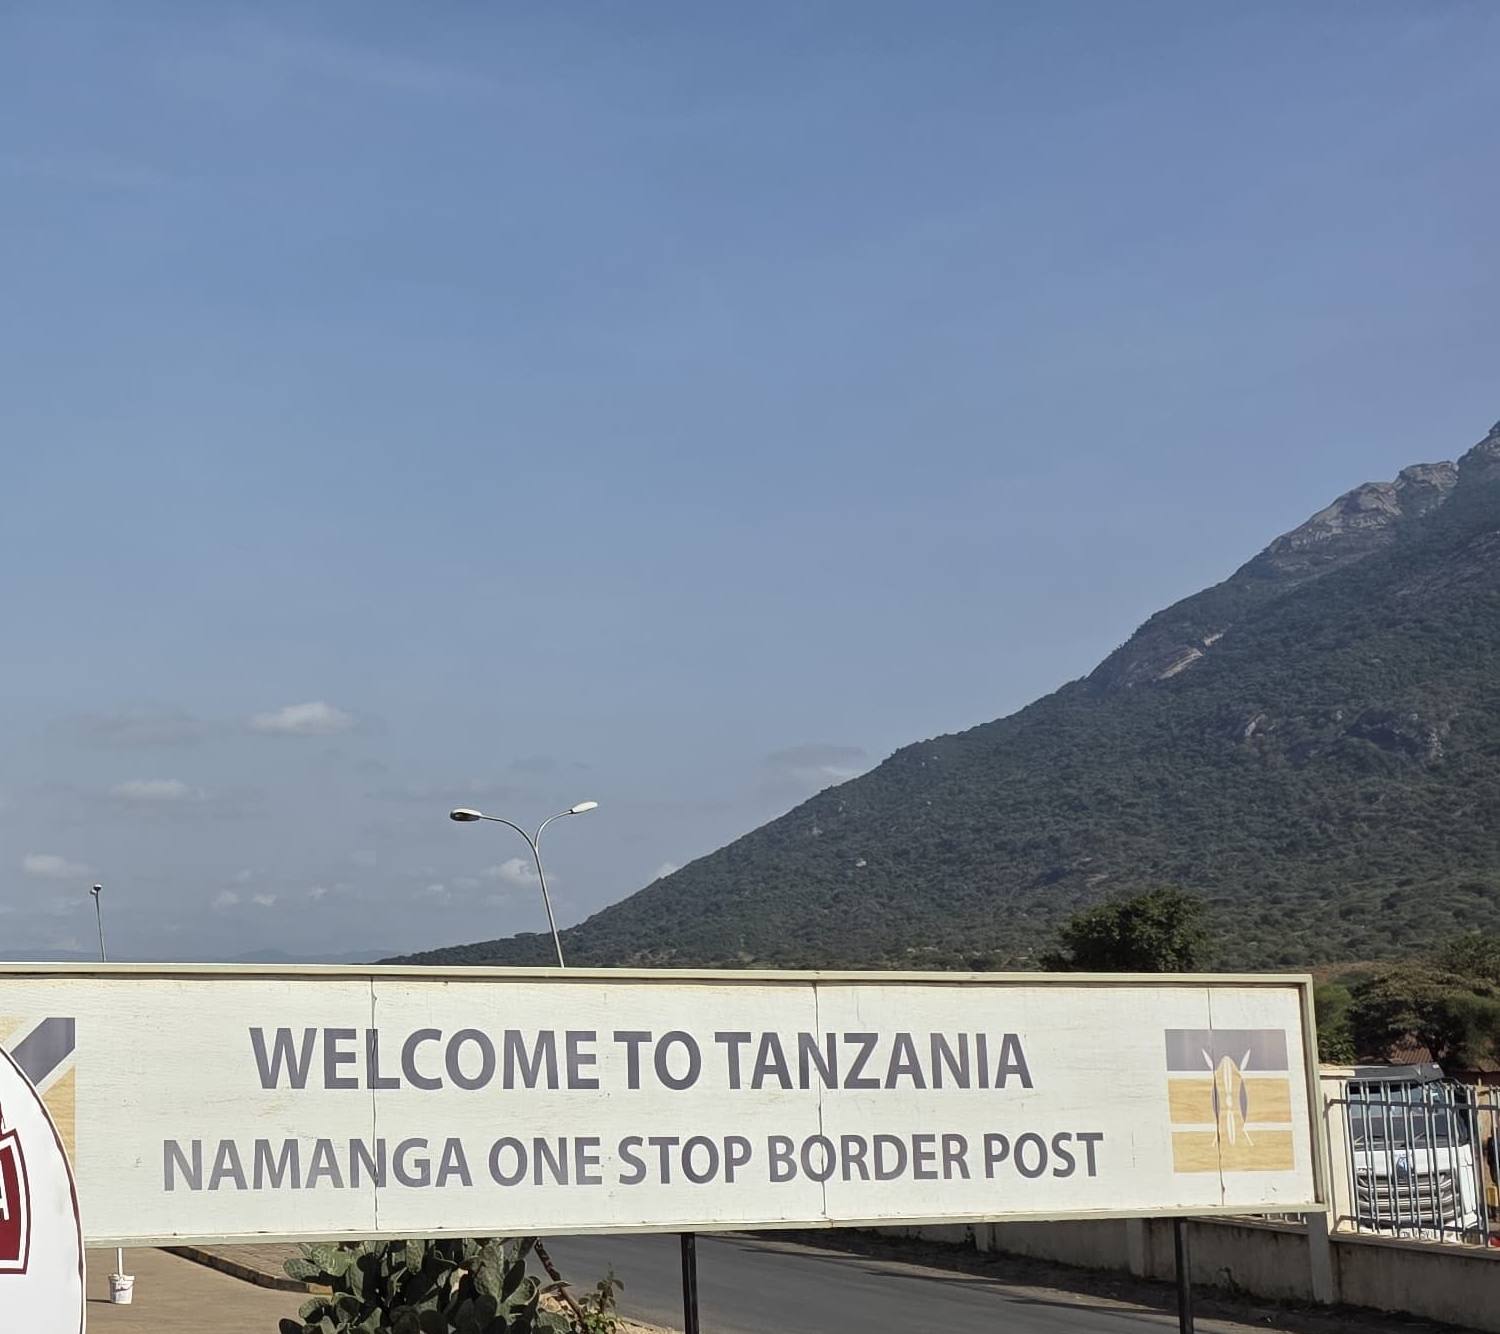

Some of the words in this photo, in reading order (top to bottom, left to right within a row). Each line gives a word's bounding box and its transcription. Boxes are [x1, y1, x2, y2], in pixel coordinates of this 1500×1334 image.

[249, 1027, 599, 1090] WELCOME
[613, 1031, 701, 1090] TO
[714, 1032, 1033, 1090] TANZANIA
[164, 1138, 473, 1191] NAMANGA
[489, 1137, 602, 1187] ONE
[618, 1136, 752, 1185] STOP
[768, 1134, 971, 1182] BORDER
[984, 1132, 1103, 1178] POST
